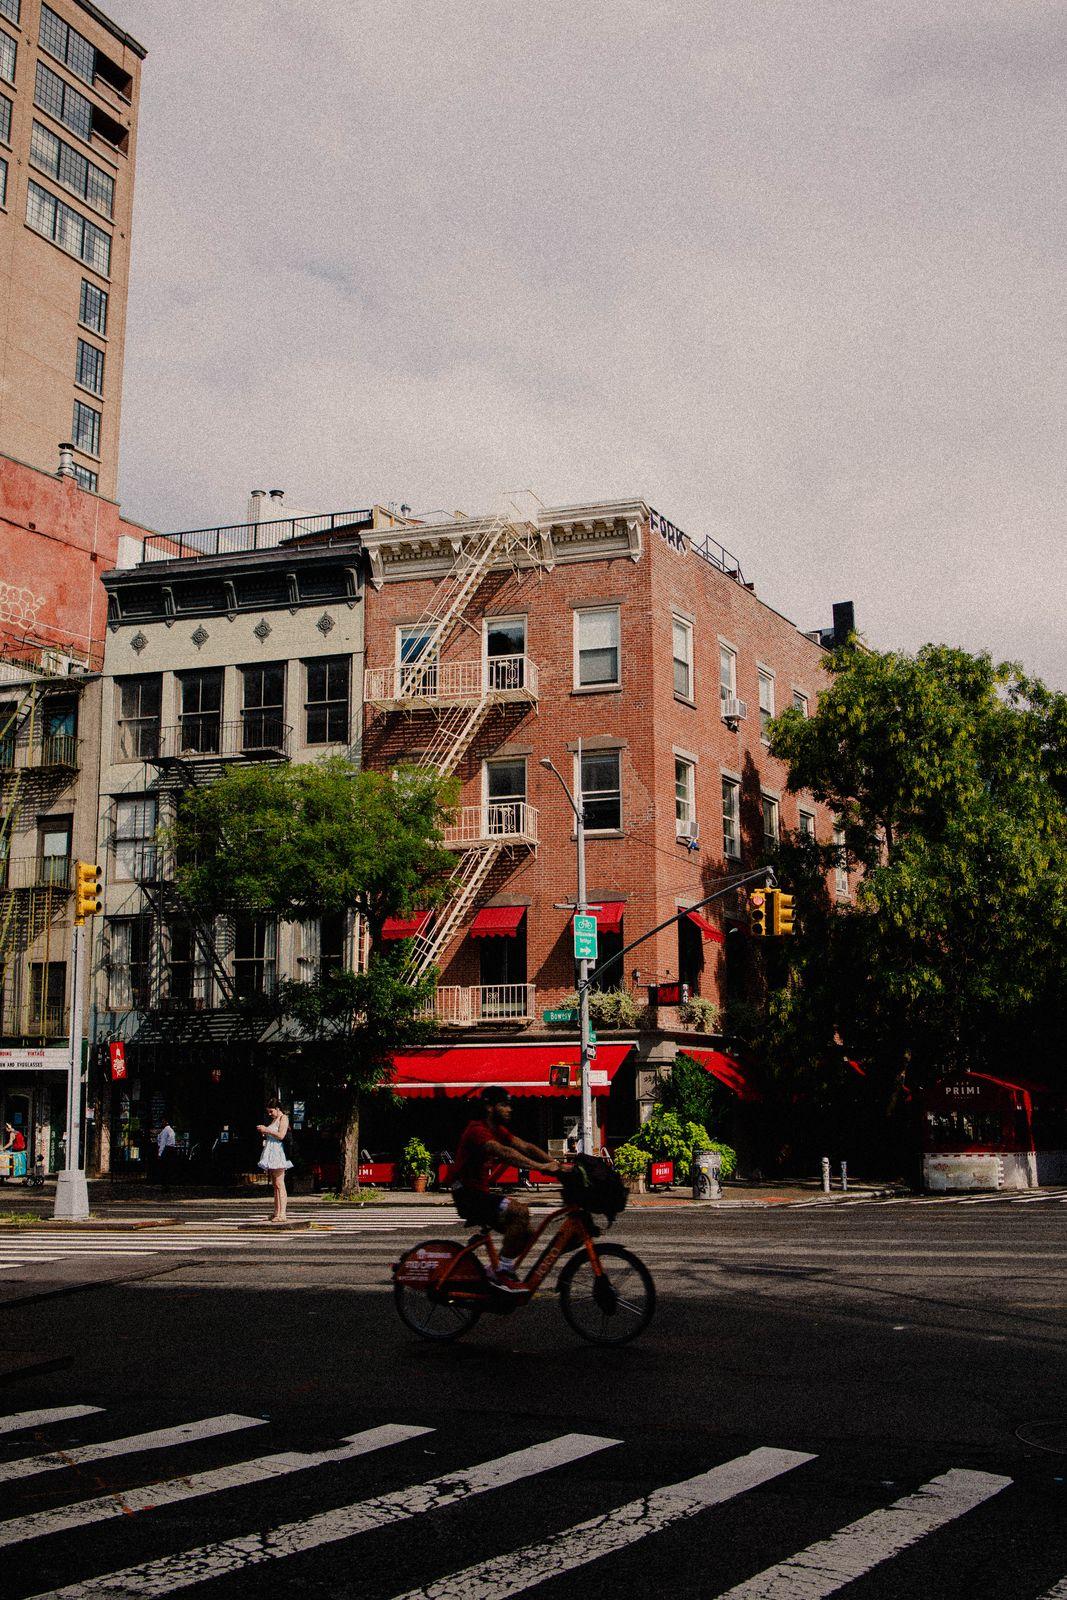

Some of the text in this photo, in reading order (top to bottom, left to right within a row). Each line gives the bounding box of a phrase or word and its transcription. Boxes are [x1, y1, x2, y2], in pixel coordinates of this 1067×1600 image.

[550, 1012, 572, 1021] Bowery
[945, 1087, 980, 1095] PRIMI
[655, 1168, 670, 1176] PRIMI
